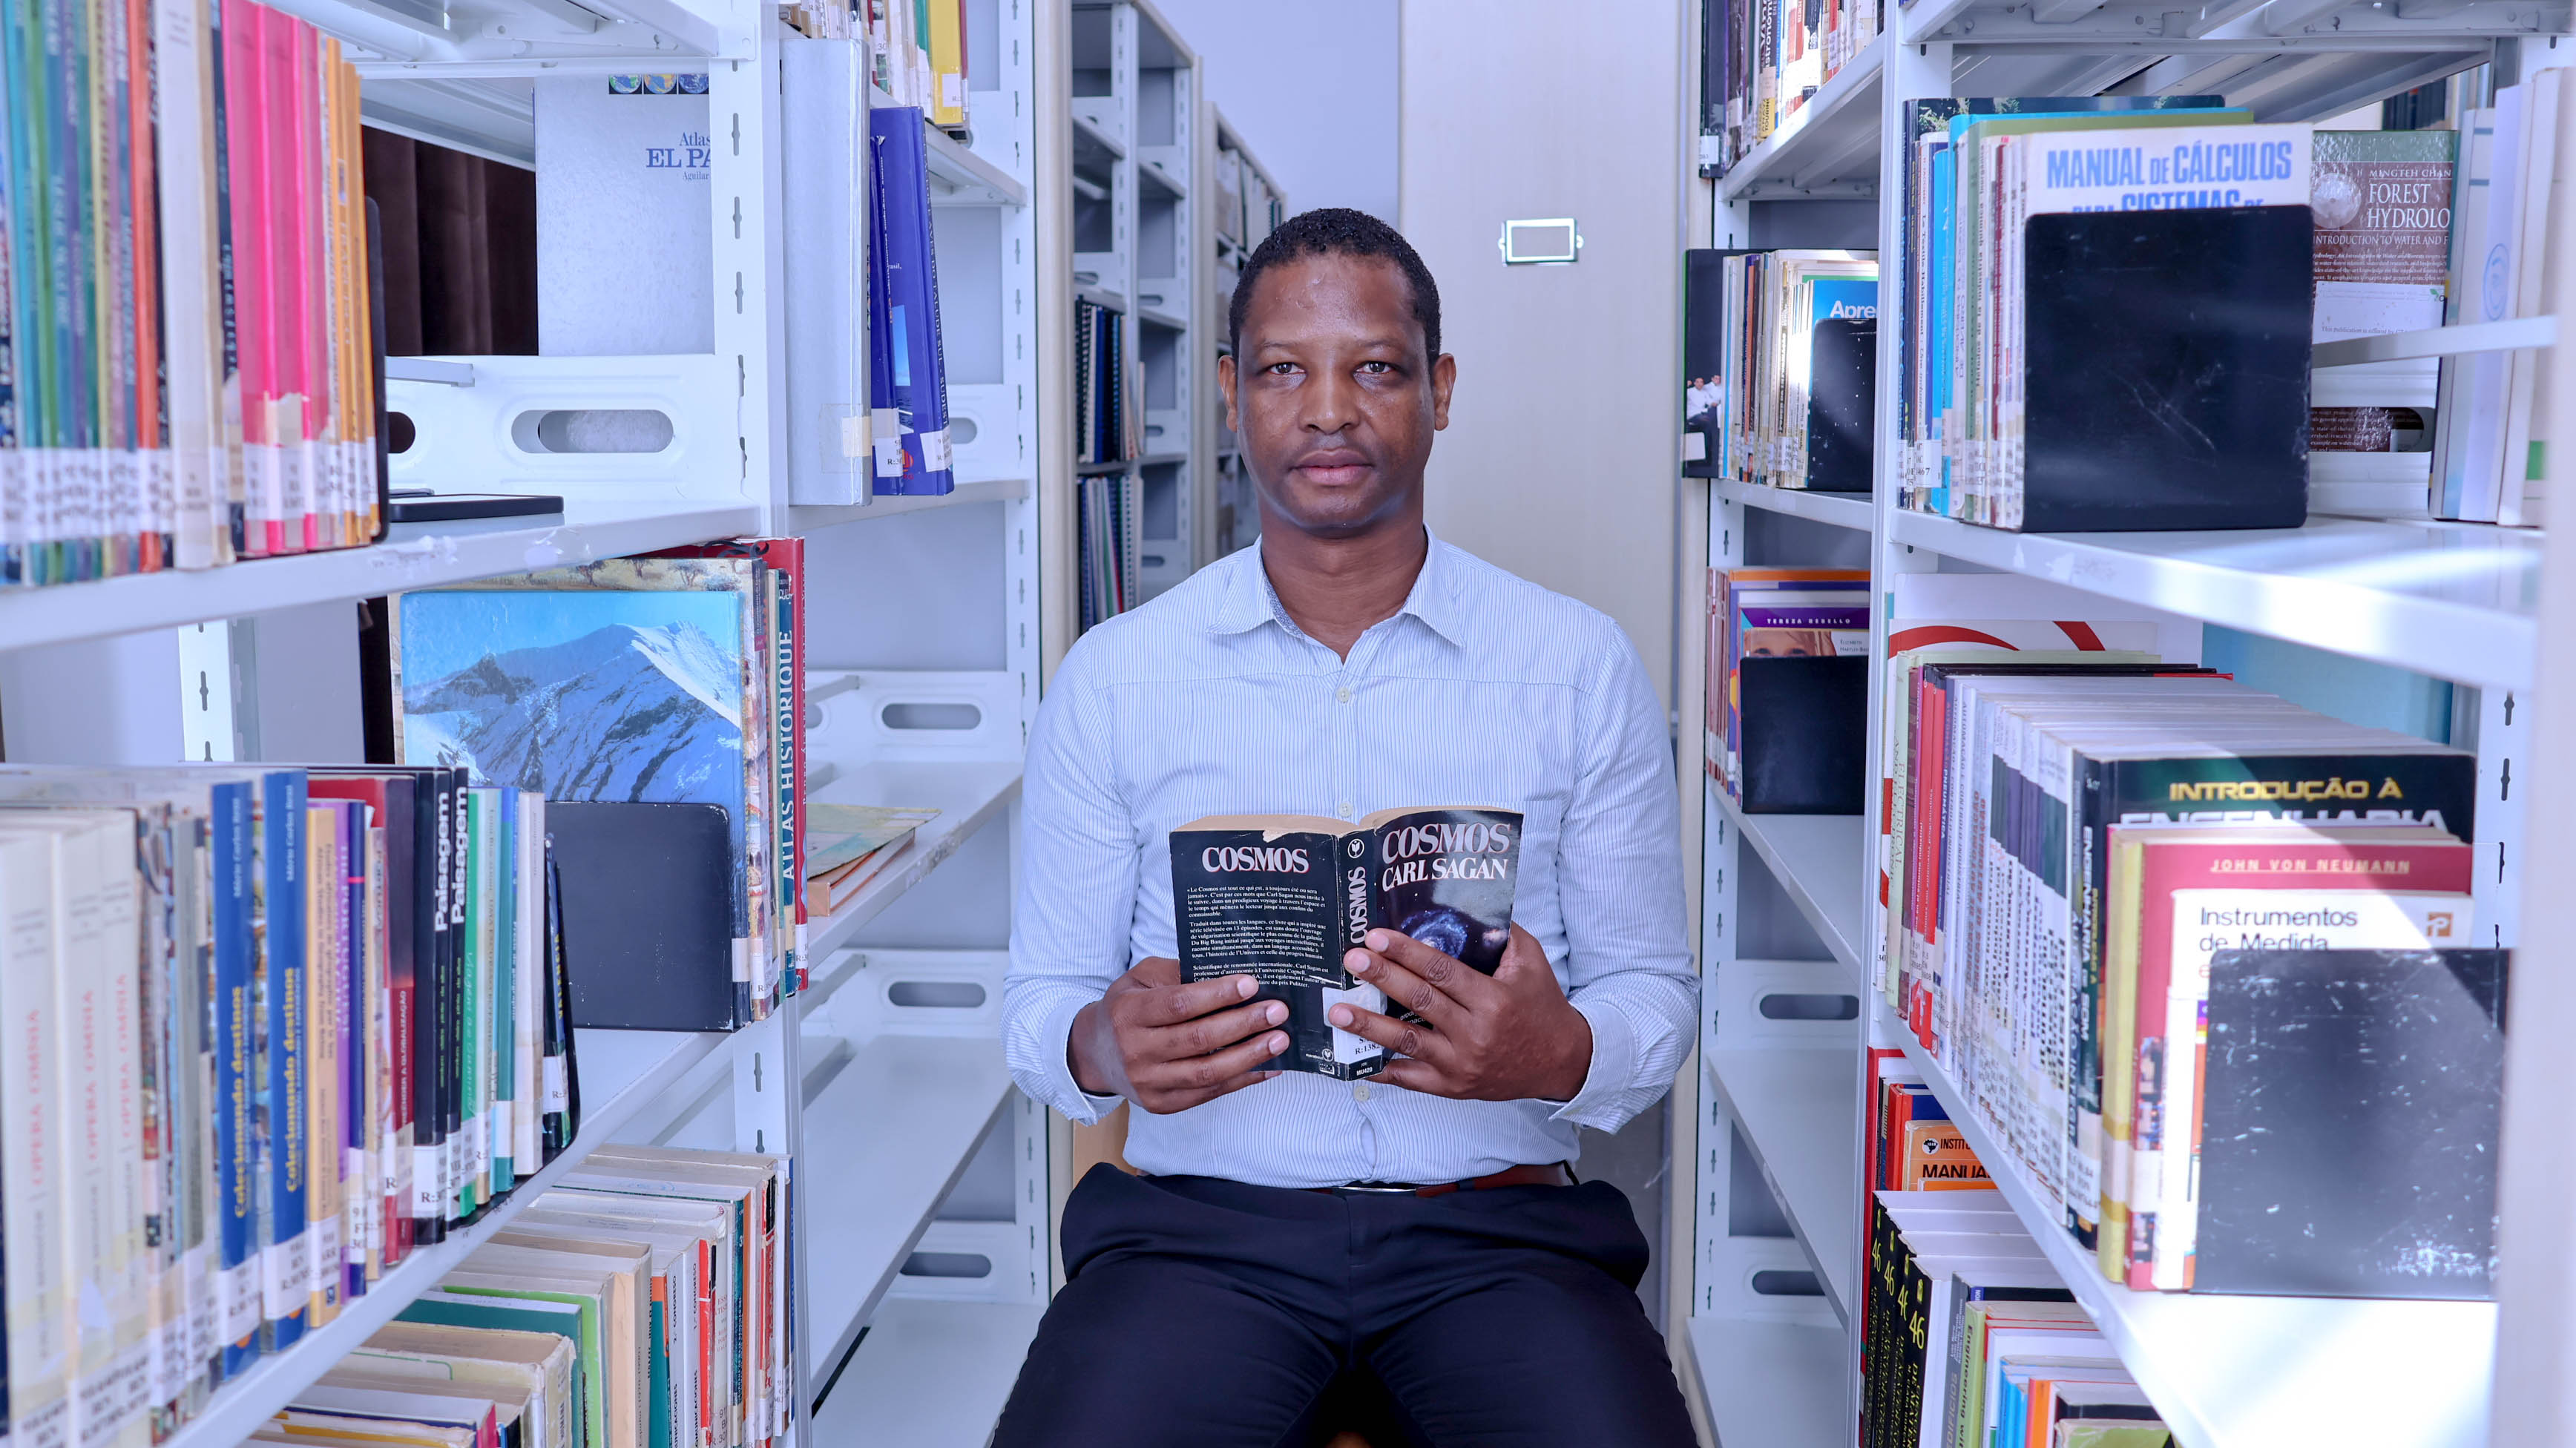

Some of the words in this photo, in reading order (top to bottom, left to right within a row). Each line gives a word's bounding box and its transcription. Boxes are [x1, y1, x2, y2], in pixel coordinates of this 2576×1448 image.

[680, 132, 710, 147] Atlas
[645, 148, 682, 168] EL
[683, 171, 709, 181] Aguilar
[2047, 147, 2145, 188] MANUAL
[2150, 157, 2169, 185] DE
[2173, 140, 2293, 183] CÁLCULOS
[2369, 169, 2418, 177] MINGTEH
[2368, 183, 2431, 204] FOREST
[2367, 208, 2451, 228] HYDROLO
[2380, 236, 2393, 245] TO
[2394, 236, 2421, 245] WATER
[2422, 236, 2441, 245] AND
[779, 630, 794, 790] HISTORIQUE
[2169, 777, 2370, 802] INTRODUÇÃO
[2377, 777, 2403, 800] À
[1896, 763, 1905, 869] ELECTRICAL
[451, 786, 469, 924] Paisagem
[781, 800, 794, 880] ATLAS
[1382, 823, 1511, 865] COSMOS
[435, 792, 450, 932] Paisagem
[1201, 846, 1310, 874] COSMOS
[1382, 858, 1430, 892] CARL
[1431, 856, 1508, 881] SAGAN
[2209, 859, 2260, 874] JOHN
[2269, 859, 2307, 874] VON
[2317, 860, 2411, 875] NEUMANN
[1347, 866, 1369, 945] COSMOS
[2083, 826, 2093, 963] ENGENHARIA
[1300, 927, 1322, 935] l'ouvrage
[2201, 906, 2359, 927] Instrumentos
[2199, 933, 2228, 952] de
[2241, 933, 2328, 951] Medida
[283, 967, 295, 1052] destinos
[231, 986, 243, 1073] destinos
[283, 1056, 298, 1193] Colecionando
[231, 1077, 246, 1218] Colecionando
[1872, 1238, 1882, 1272] 46
[1884, 1260, 1895, 1296] 46
[1909, 1310, 1925, 1350] 46
[1960, 1325, 1973, 1419] Engineering
